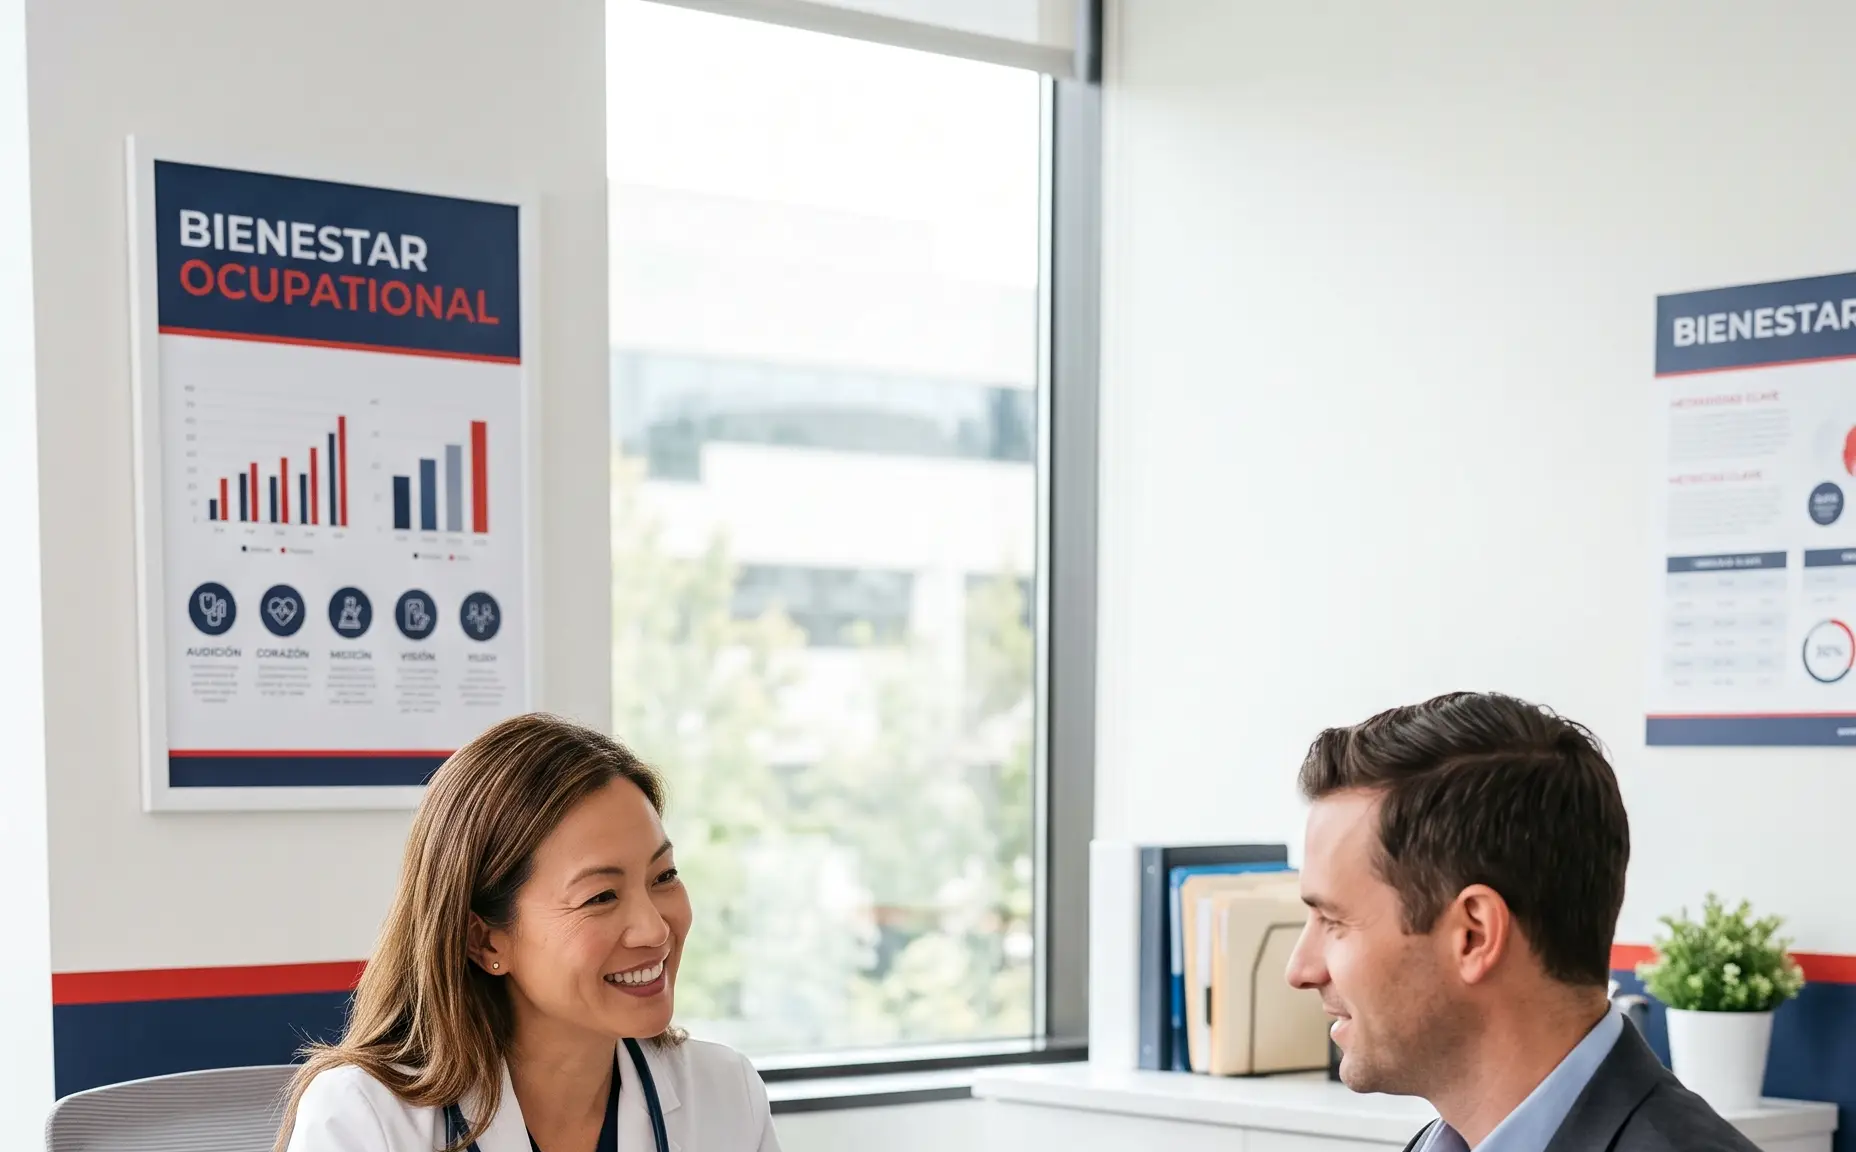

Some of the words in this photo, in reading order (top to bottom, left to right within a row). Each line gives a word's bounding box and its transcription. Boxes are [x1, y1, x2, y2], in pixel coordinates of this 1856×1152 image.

[179, 208, 428, 272] BIENESTAR
[179, 258, 500, 325] OCUPATIONAL
[1672, 298, 1856, 348] BIENESTAR
[186, 645, 242, 658] AUDICIÓN
[256, 646, 310, 660] CORAZÓN
